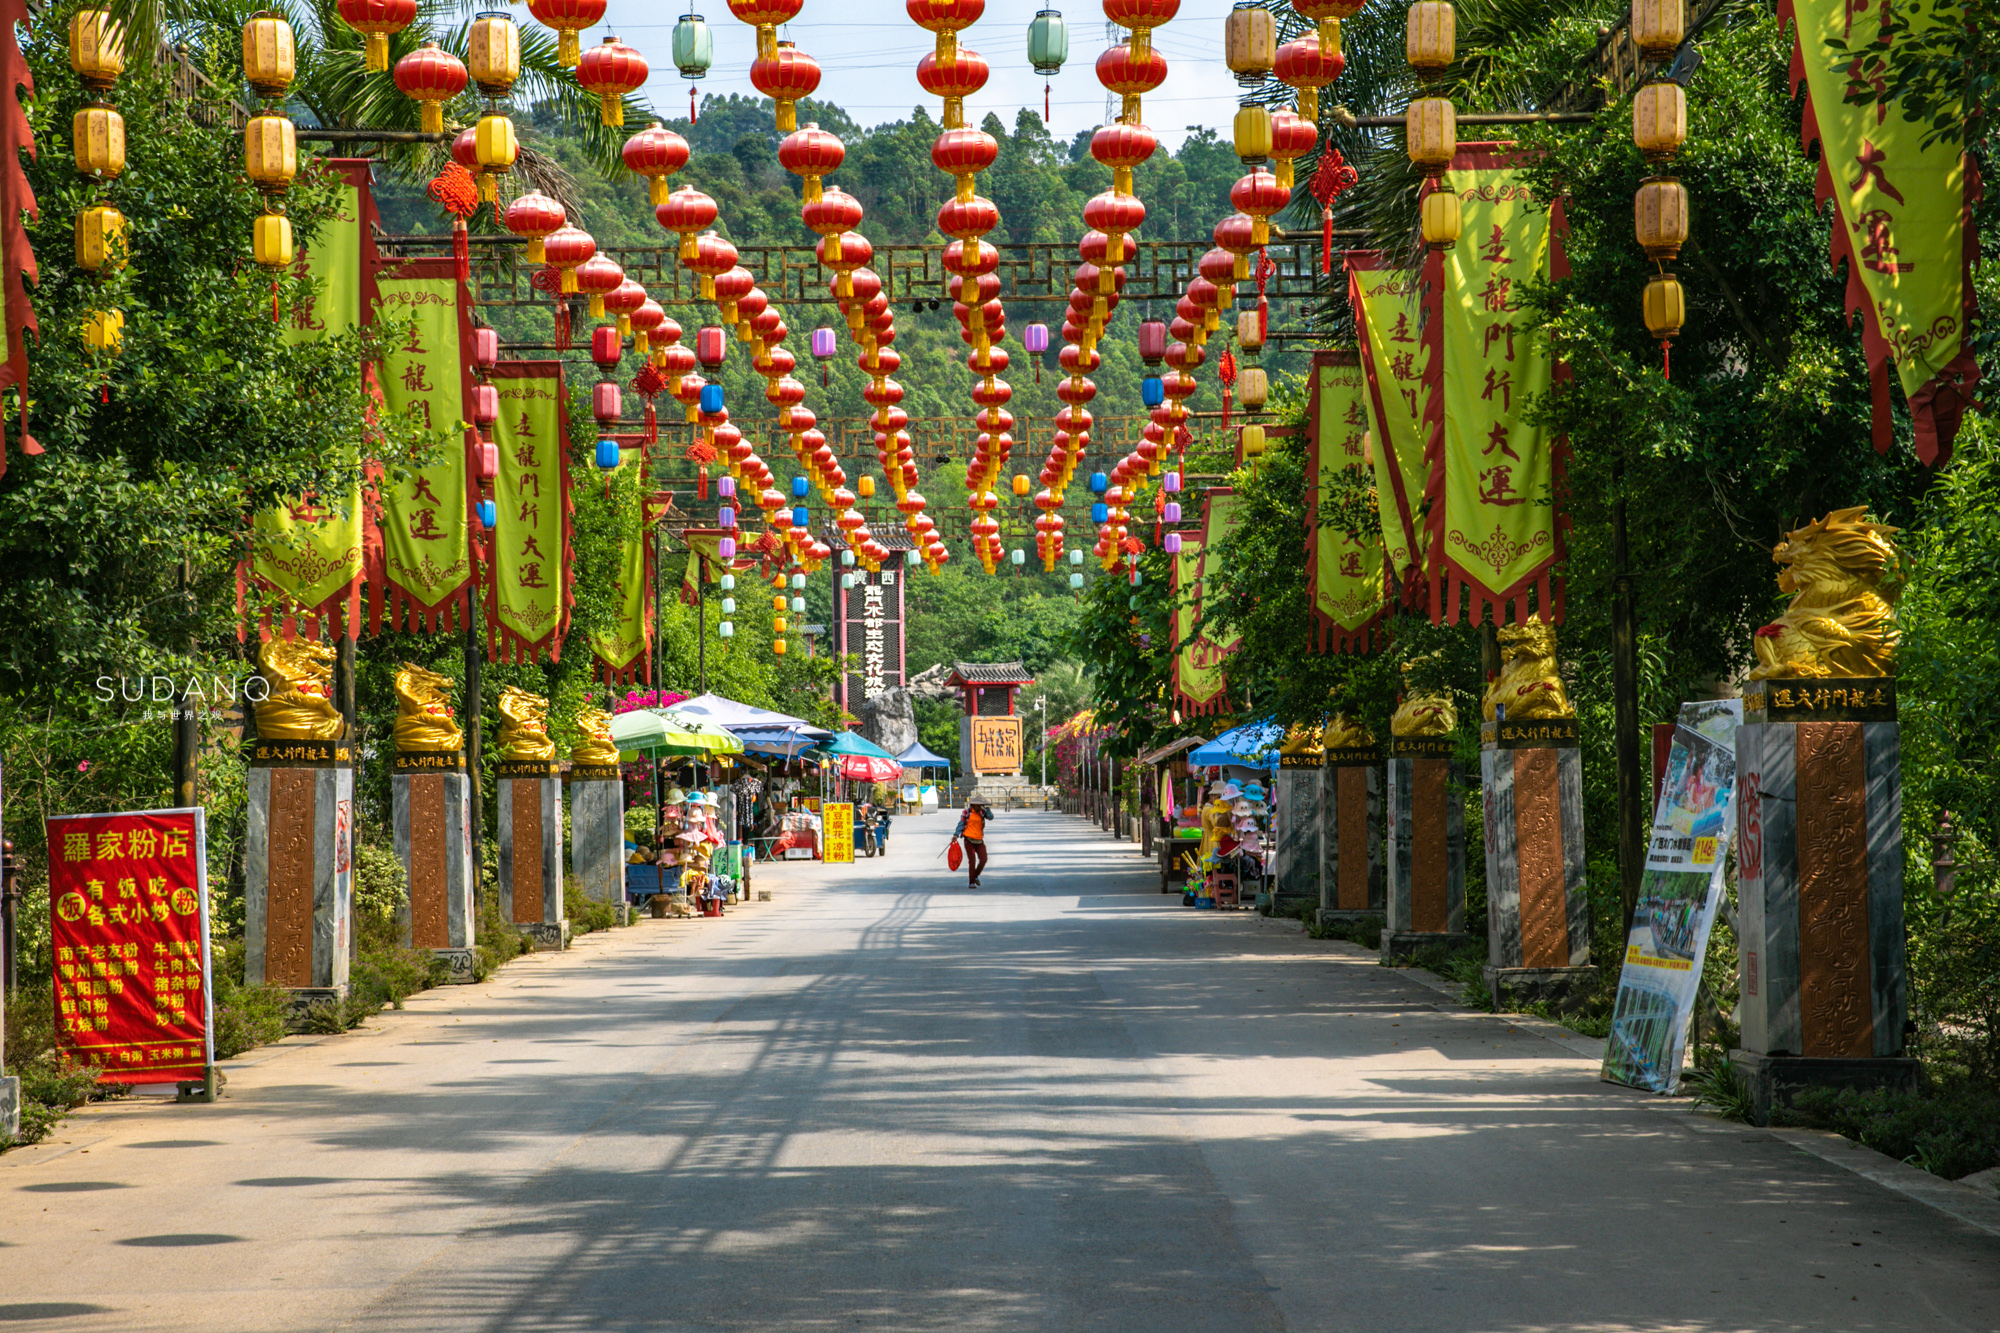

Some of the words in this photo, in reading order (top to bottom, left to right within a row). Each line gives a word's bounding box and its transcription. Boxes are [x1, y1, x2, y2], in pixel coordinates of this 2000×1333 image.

[1478, 224, 1527, 507] 走龍門行大運
[512, 412, 550, 589] 走龍門行大運
[832, 811, 844, 839] 豆腐花
[63, 827, 189, 863] 羅家粉店
[832, 842, 845, 861] 凉粉
[61, 896, 83, 919] 饭
[176, 890, 197, 914] 粉
[87, 900, 170, 926] 各式小炒
[59, 942, 138, 961] 南宁老友粉
[153, 940, 199, 957] 牛腩粉
[59, 960, 139, 980] 柳州螺蛳粉
[154, 958, 201, 975] 牛肉粉
[61, 979, 124, 997] 宾阳酸粉
[154, 975, 200, 992] 猪杂粉
[61, 997, 109, 1015] 鲜肉粉
[155, 993, 185, 1009] 炒粉
[63, 1015, 109, 1032] 叉烧粉
[156, 1010, 185, 1027] 炒饭
[120, 1050, 142, 1062] 白粥
[150, 1048, 183, 1060] 玉米粥
